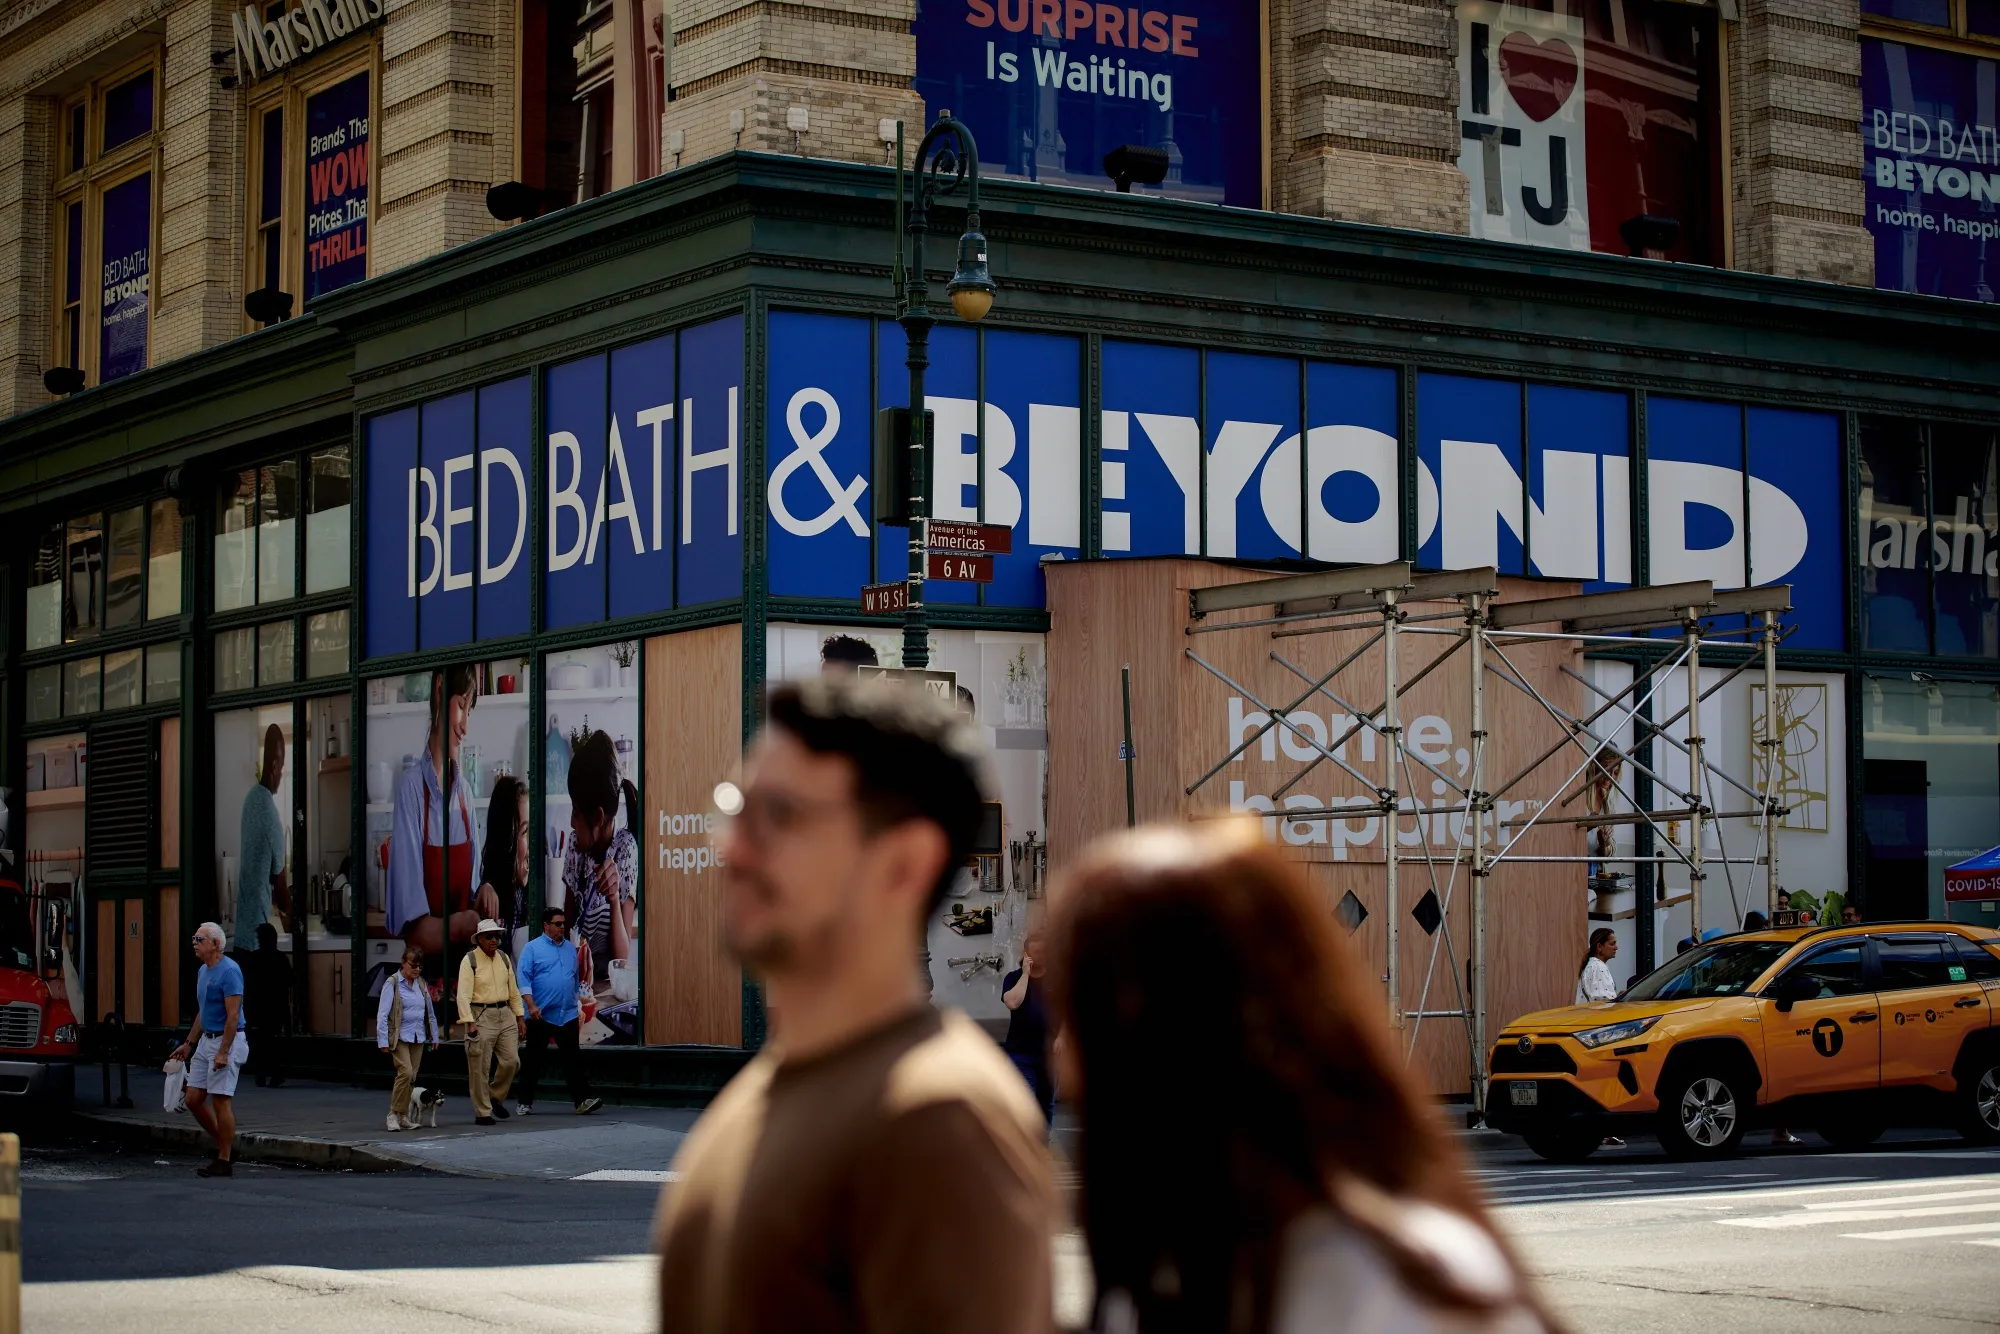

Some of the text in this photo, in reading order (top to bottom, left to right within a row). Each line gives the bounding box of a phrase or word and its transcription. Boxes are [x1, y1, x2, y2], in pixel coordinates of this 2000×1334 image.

[965, 0, 1199, 58] SURPRISE
[986, 41, 1172, 113] Is Waiting
[1472, 21, 1490, 115] I
[310, 117, 370, 158] Brands Tha
[1873, 108, 1932, 155] BED
[310, 141, 369, 206] WOW
[1462, 120, 1568, 226] TJ
[308, 197, 369, 237] Prices Tha
[1876, 204, 2000, 242] home, happi
[104, 259, 122, 287] BED
[122, 247, 147, 279] BATH
[308, 225, 367, 273] THRILL
[104, 273, 149, 306] BEYOND
[123, 303, 146, 319] happier
[408, 386, 1808, 598] BED BATH & BEYOND
[929, 525, 978, 536] Avenue of the
[929, 533, 986, 551] Americas
[943, 559, 977, 579] 6 Av
[865, 590, 904, 611] W 19 St
[925, 681, 944, 697] AY
[1228, 697, 1470, 778] home,
[1796, 1025, 1836, 1052] NYC T
